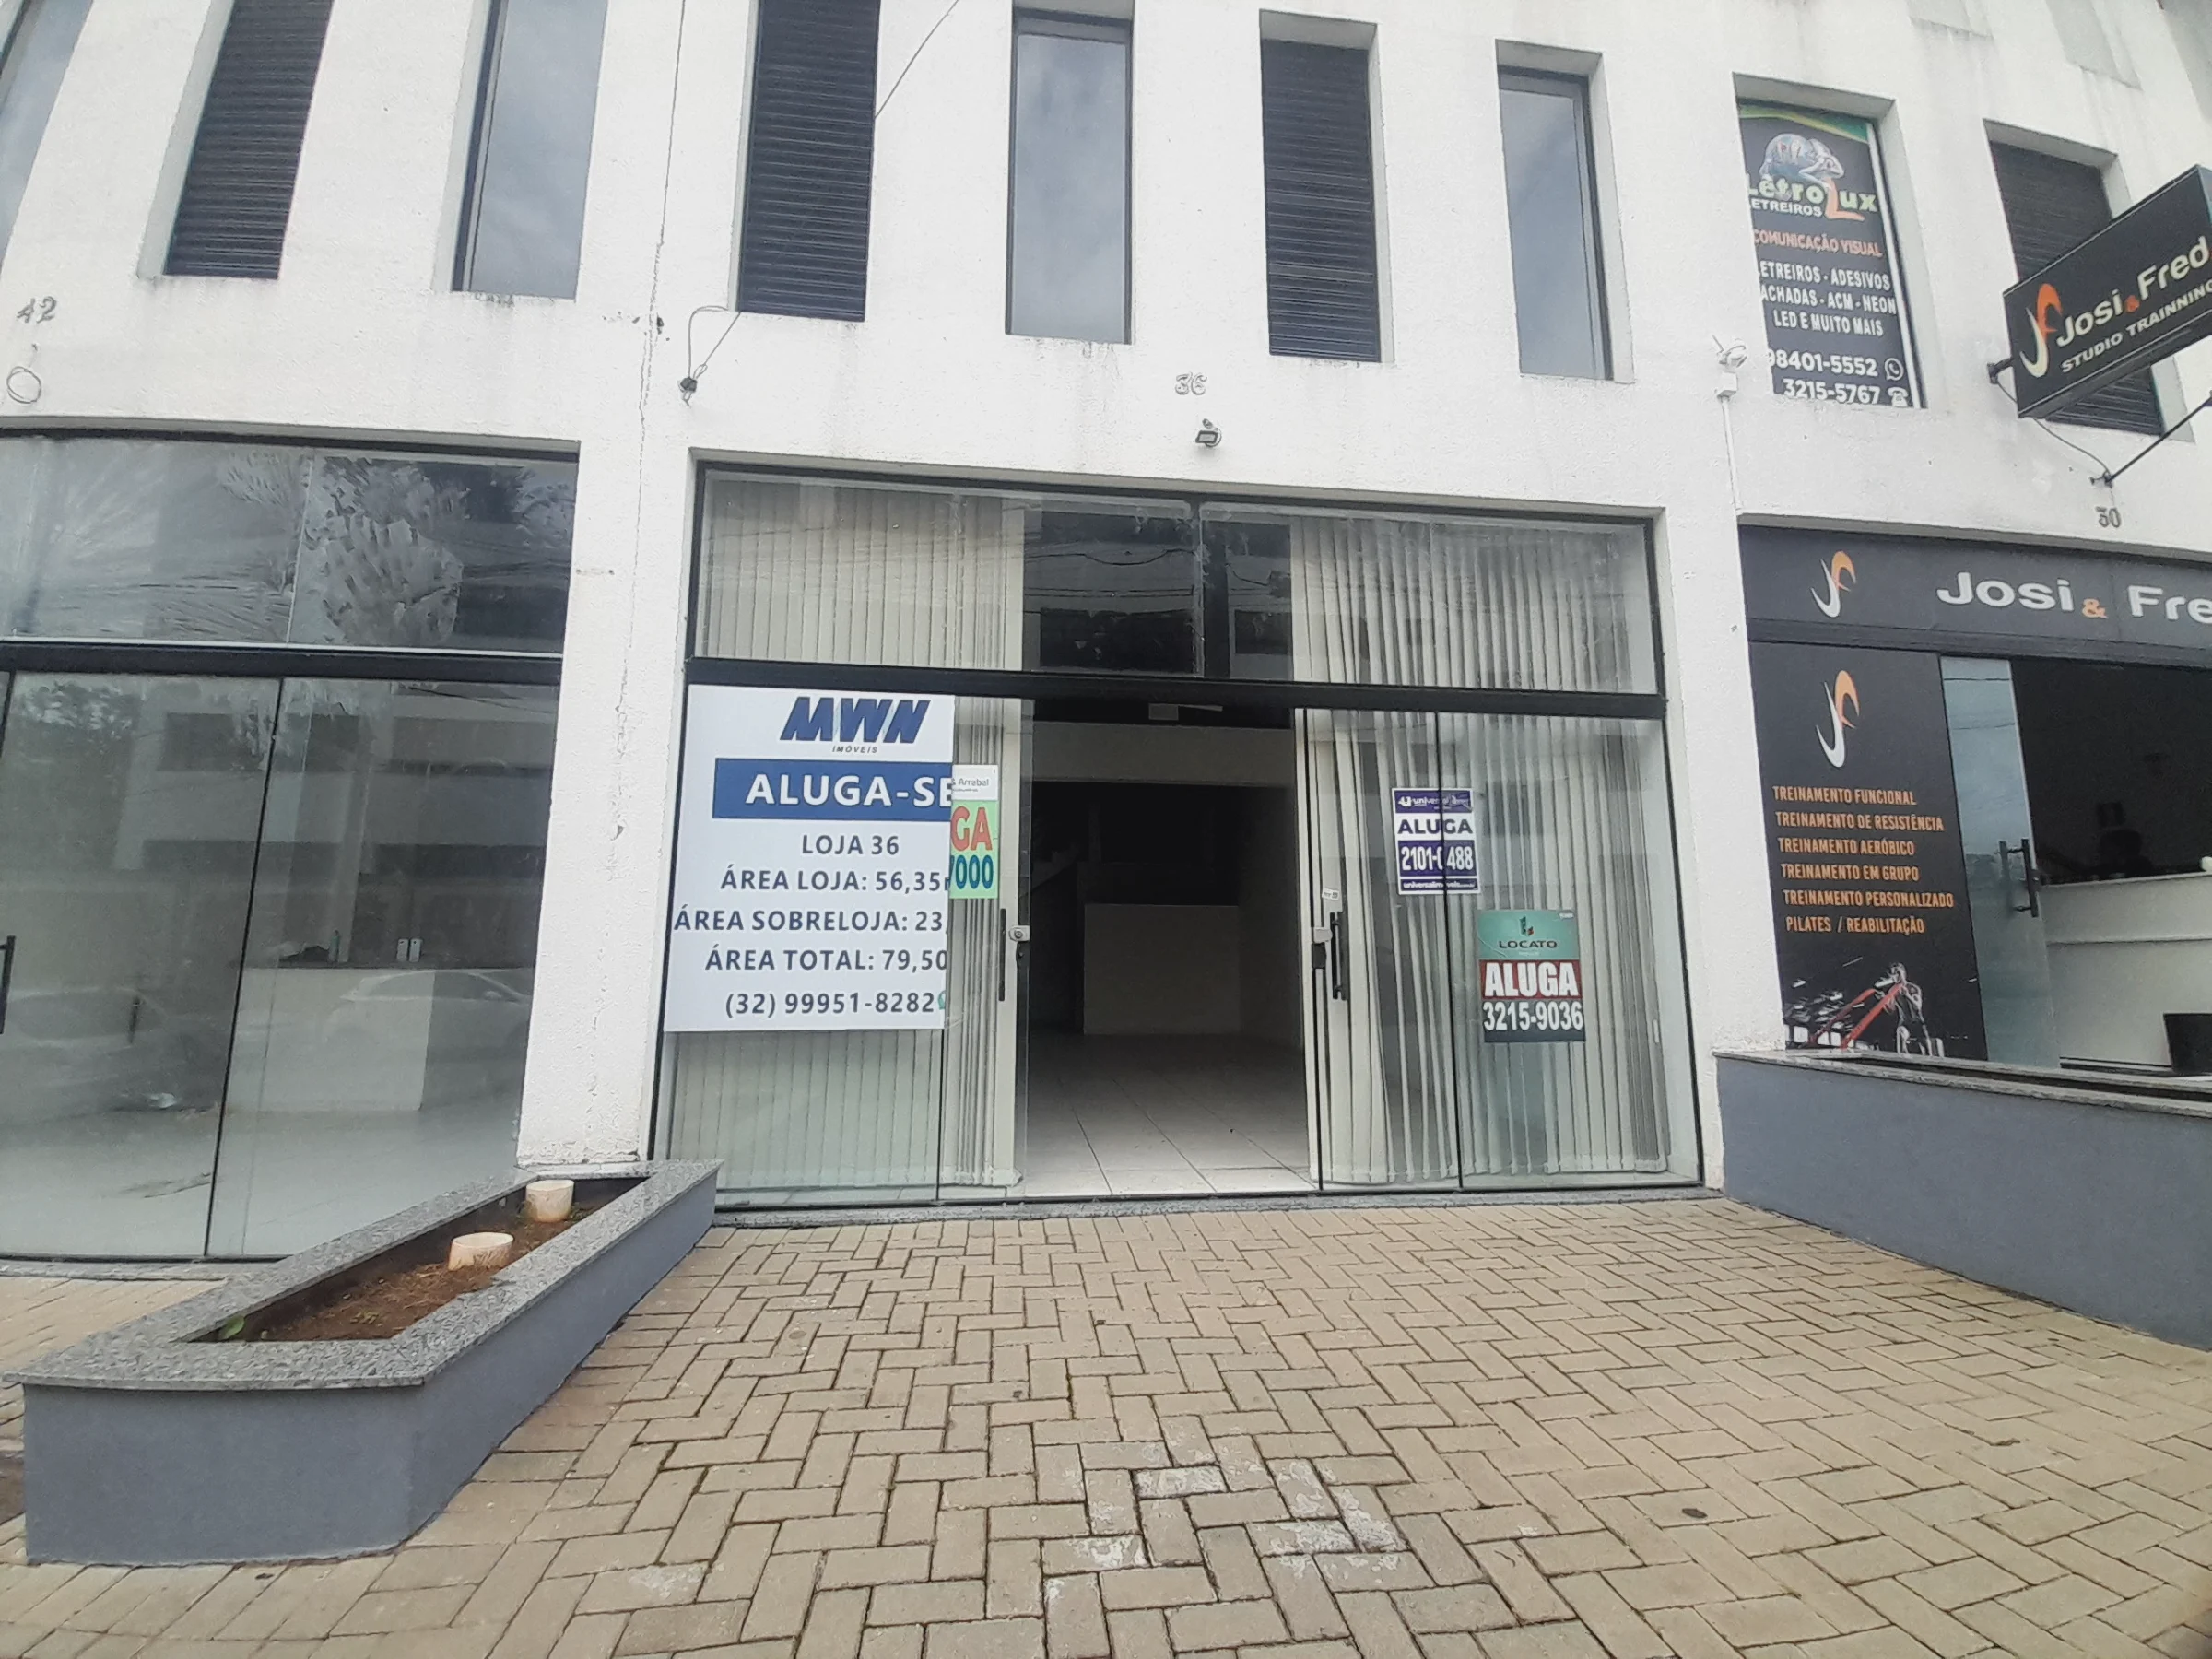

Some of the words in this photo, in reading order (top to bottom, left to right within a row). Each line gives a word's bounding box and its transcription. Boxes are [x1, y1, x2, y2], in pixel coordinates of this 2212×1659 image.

[1750, 198, 1823, 218] ETREIROS
[1841, 240, 1883, 257] VISUAL
[1759, 261, 1821, 284] ETREIROS
[1831, 268, 1891, 290] ADESIVOS
[1827, 292, 1854, 311] ACM
[1863, 294, 1897, 315] NEON
[2056, 289, 2124, 347] Josi
[2136, 235, 2209, 300] Fred
[17, 296, 57, 324] 42
[1773, 310, 1797, 327] LED
[1799, 312, 1809, 330] E
[1811, 313, 1851, 334] MUITO
[1853, 317, 1884, 337] MAIS
[2059, 332, 2124, 373] STUDIO
[1174, 371, 1208, 395] 36
[1783, 378, 1881, 405] 3215-5767
[2095, 506, 2122, 528] 30
[1936, 571, 2075, 613] Josi
[2127, 584, 2212, 625] Fre
[780, 696, 932, 745] MWN
[832, 744, 878, 754] IMÓVEIS
[745, 773, 952, 807] ALUGA-SE
[959, 778, 989, 786] Arrabal
[1772, 786, 1852, 804] TREINAMENTO
[1854, 788, 1917, 806] FUNCIONAL
[1397, 818, 1474, 834] ALUGA
[1775, 811, 1854, 829] TREINAMENTO
[1857, 815, 1872, 829] DE
[1875, 814, 1945, 831] RESISTÊNCIA
[802, 834, 864, 855] LOJA
[871, 834, 900, 855] 36
[1778, 837, 1857, 854] TREINAMENTO
[1860, 838, 1915, 856] AERÓBICO
[721, 864, 789, 890] ÁREA
[797, 869, 867, 891] LOJA:
[950, 854, 994, 890] 000
[1781, 863, 1860, 880] TREINAMENTO
[1863, 865, 1880, 880] EM
[1882, 865, 1919, 882] GRUPO
[1783, 889, 1863, 906] TREINAMENTO
[1865, 891, 1955, 908] PERSONALIZADO
[674, 904, 744, 931] ÁREA
[751, 910, 908, 932] SOBRELOJA:
[1786, 915, 1831, 933] PILATES
[1846, 915, 1924, 936] REABILITAÇÃO
[1499, 940, 1558, 949] LOCATO
[705, 943, 776, 971] ÁREA
[783, 949, 874, 971] TOTAL:
[882, 949, 948, 973] 79,50
[1484, 961, 1580, 997] ALUGA
[725, 992, 776, 1018] (32)
[784, 992, 935, 1014] 99951-8282
[1483, 1001, 1583, 1030] 3215-9036
